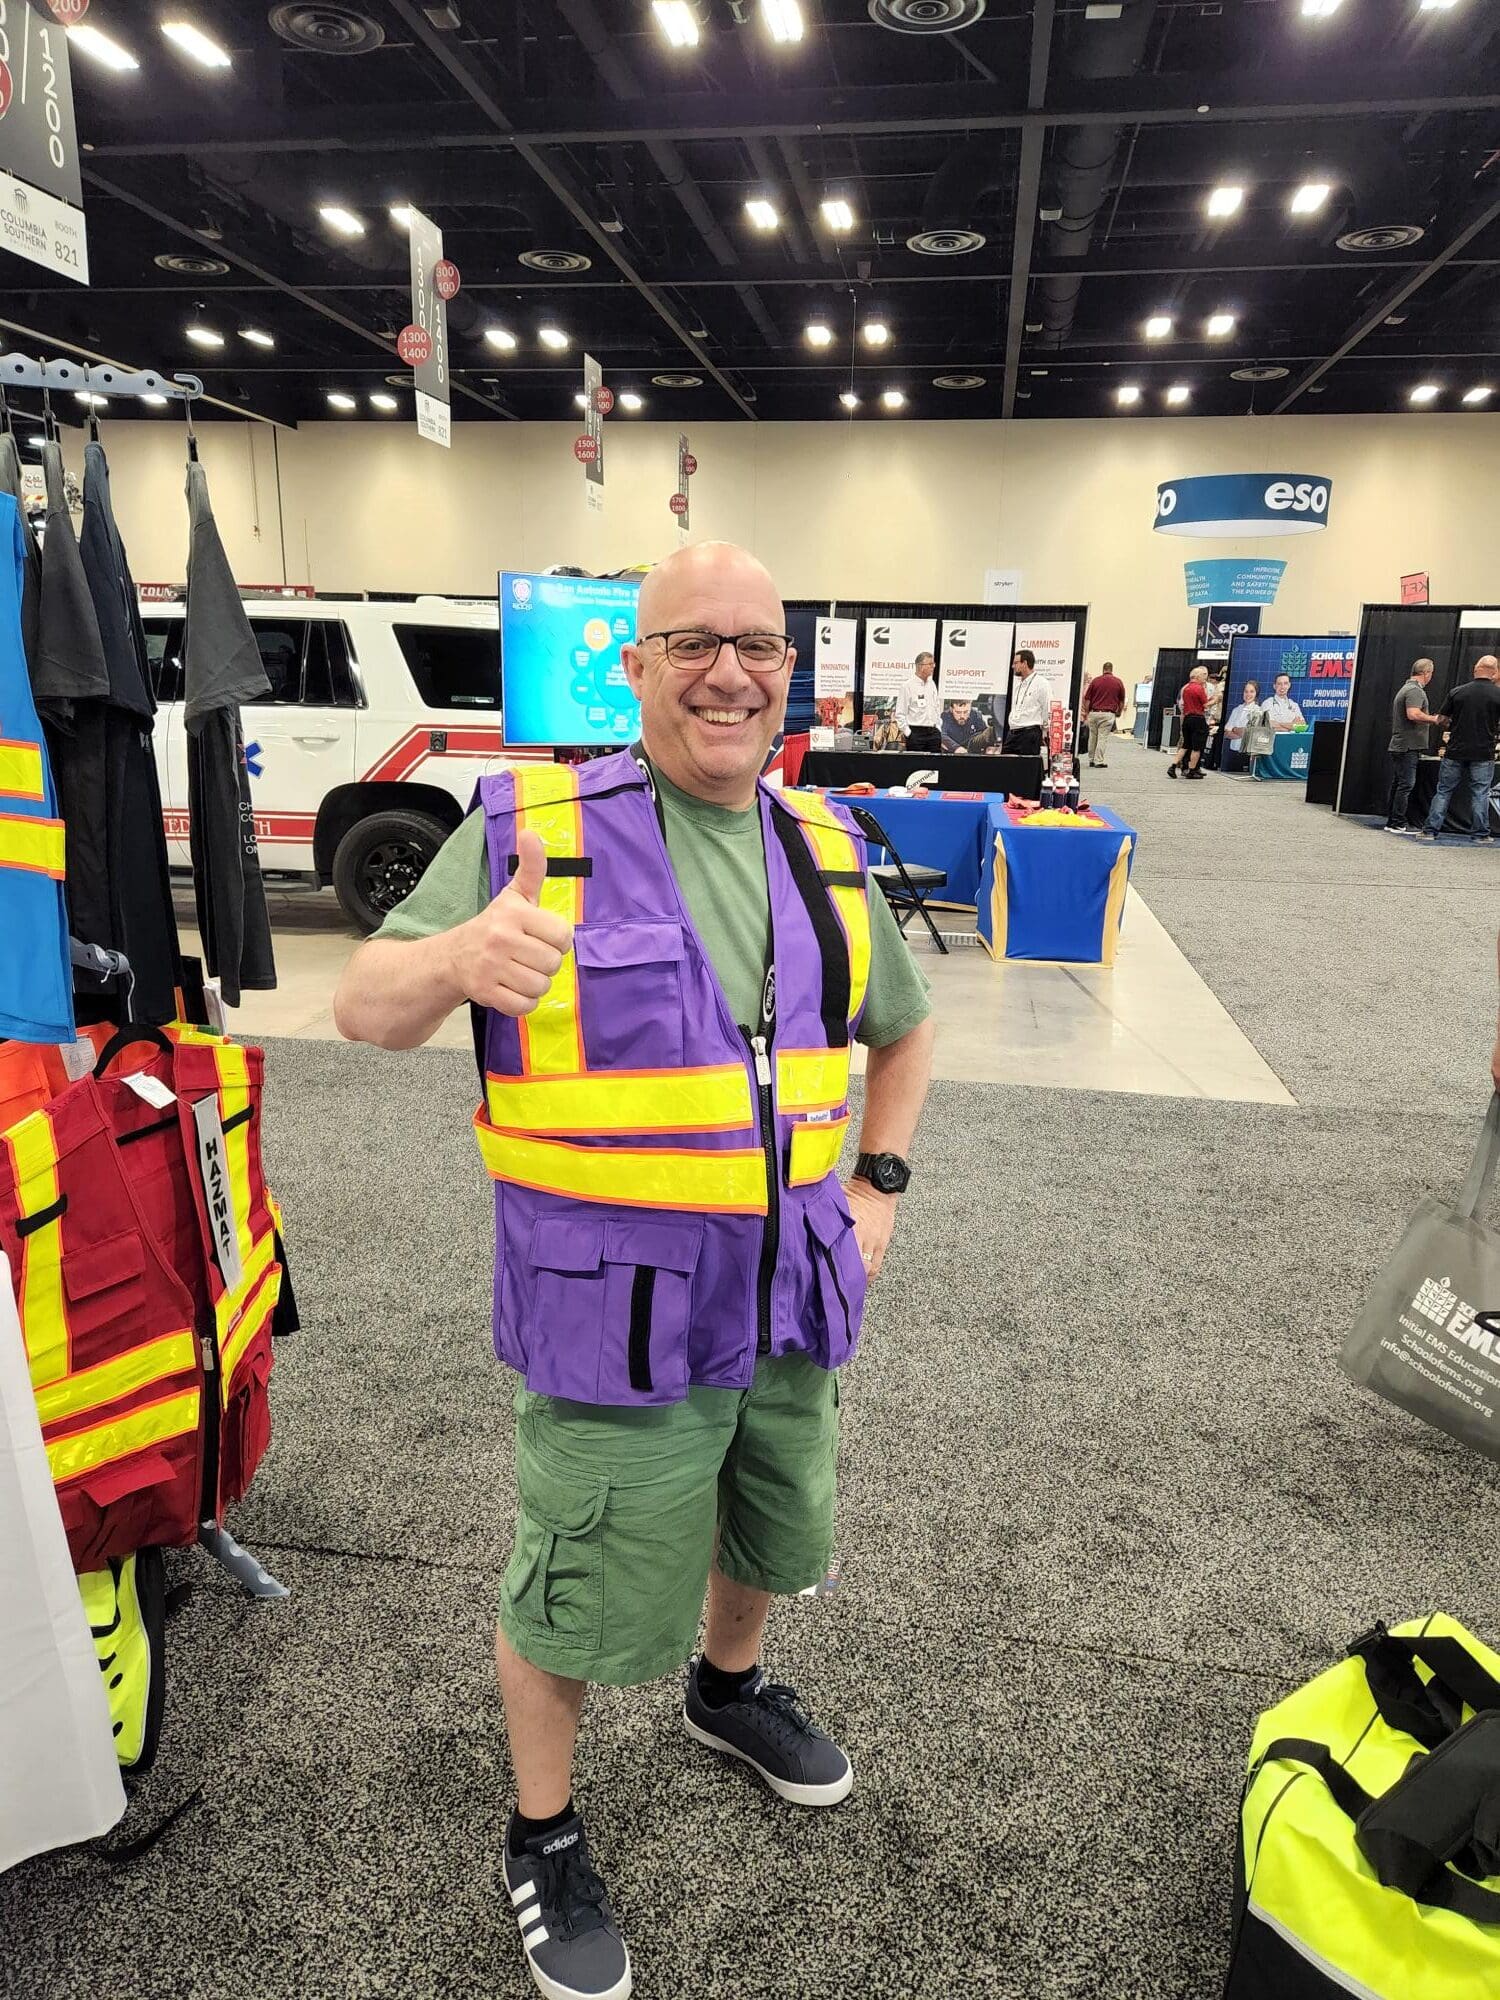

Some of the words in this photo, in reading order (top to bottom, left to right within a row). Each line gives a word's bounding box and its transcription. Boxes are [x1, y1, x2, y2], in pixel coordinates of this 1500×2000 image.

[39, 27, 65, 169] 1200
[0, 208, 48, 240] COLUMBIA
[4, 222, 47, 251] SOUTHERN
[54, 240, 79, 267] 821
[402, 332, 427, 343] 1300
[436, 303, 444, 384] 1400
[403, 347, 428, 359] 1400
[577, 440, 595, 448] 1500
[577, 450, 595, 459] 1600
[1264, 481, 1328, 514] eso
[1218, 622, 1249, 634] eso
[1020, 639, 1060, 649] CUMMINS
[1311, 651, 1345, 661] SCHOOL
[820, 663, 850, 671] INNOVATION
[946, 669, 986, 678] SUPPORT
[1313, 689, 1347, 698] PROVIDING
[1302, 699, 1337, 708] EDUCATION
[205, 1137, 232, 1258] HAZMAT
[1398, 1314, 1427, 1339] Initial
[1425, 1333, 1449, 1355] EMS
[1400, 1333, 1486, 1397] Schoolofems.org
[1379, 1337, 1496, 1419] info@schoolofems.org
[542, 1831, 579, 1856] adidas
